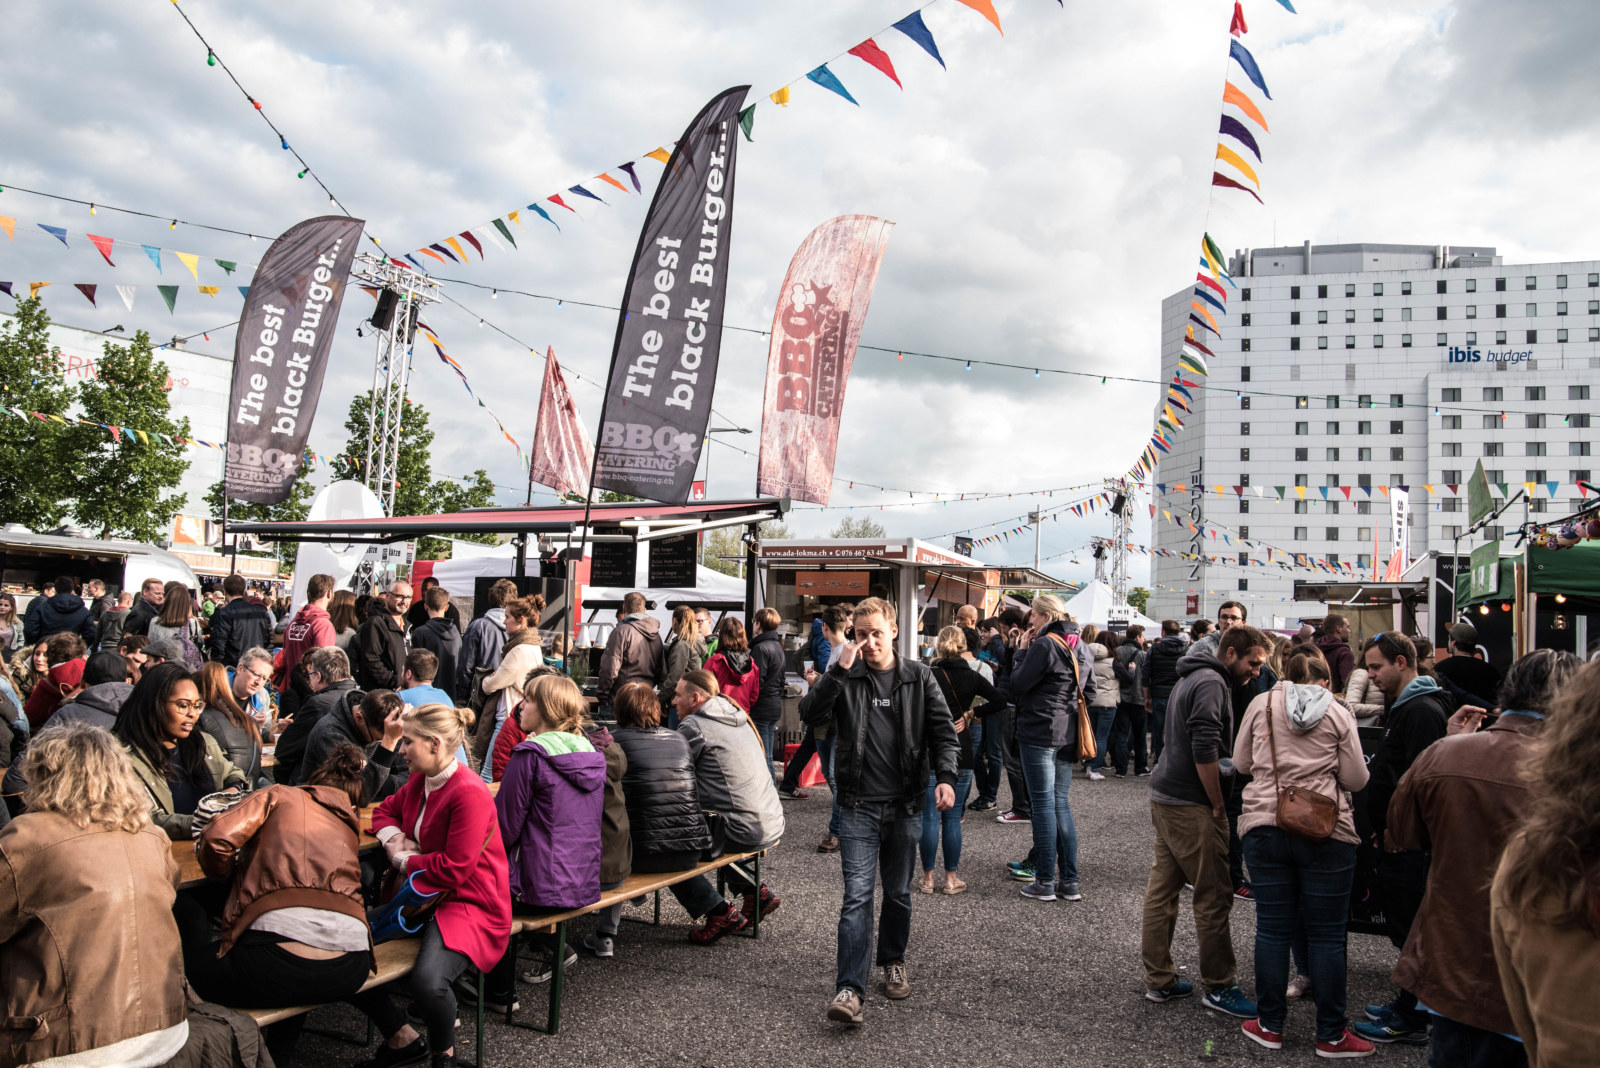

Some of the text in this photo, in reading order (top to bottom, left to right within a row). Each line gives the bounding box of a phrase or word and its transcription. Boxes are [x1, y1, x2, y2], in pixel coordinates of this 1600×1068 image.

[665, 121, 728, 411] black Burger...
[237, 303, 285, 425] The best
[622, 236, 682, 399] The best
[776, 304, 825, 415] BBQ
[1448, 346, 1533, 365] ibis budget
[271, 353, 312, 438] black
[601, 421, 681, 460] BBQ
[765, 549, 827, 557] www.ada-lokma.ch
[841, 549, 853, 557] 076
[866, 549, 875, 557] 63
[875, 549, 884, 557] 48
[1187, 456, 1203, 581] NOVOTEL
[872, 697, 891, 707] ha
